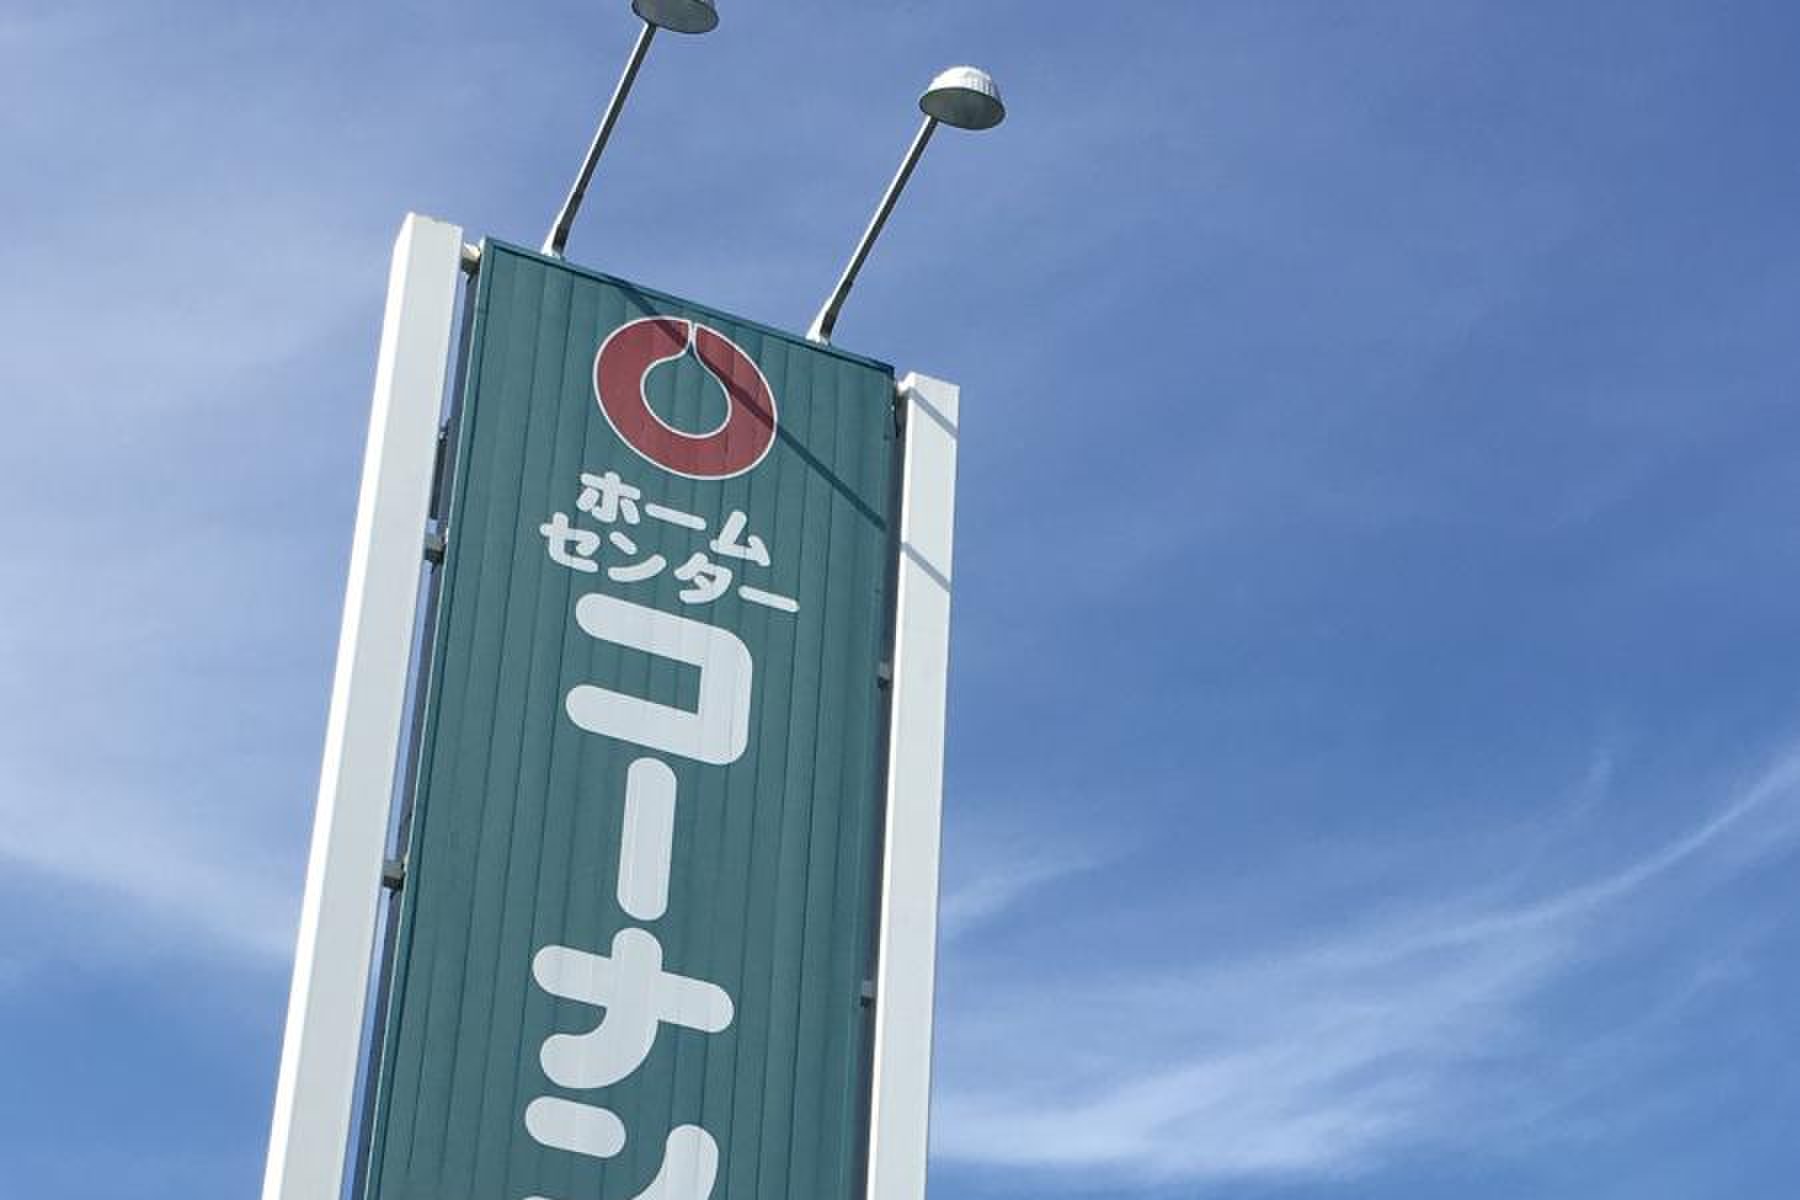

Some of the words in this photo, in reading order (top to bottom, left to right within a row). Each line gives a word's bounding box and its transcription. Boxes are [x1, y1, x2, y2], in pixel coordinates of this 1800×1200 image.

[539, 512, 799, 612] センター
[576, 471, 770, 566] ホーム
